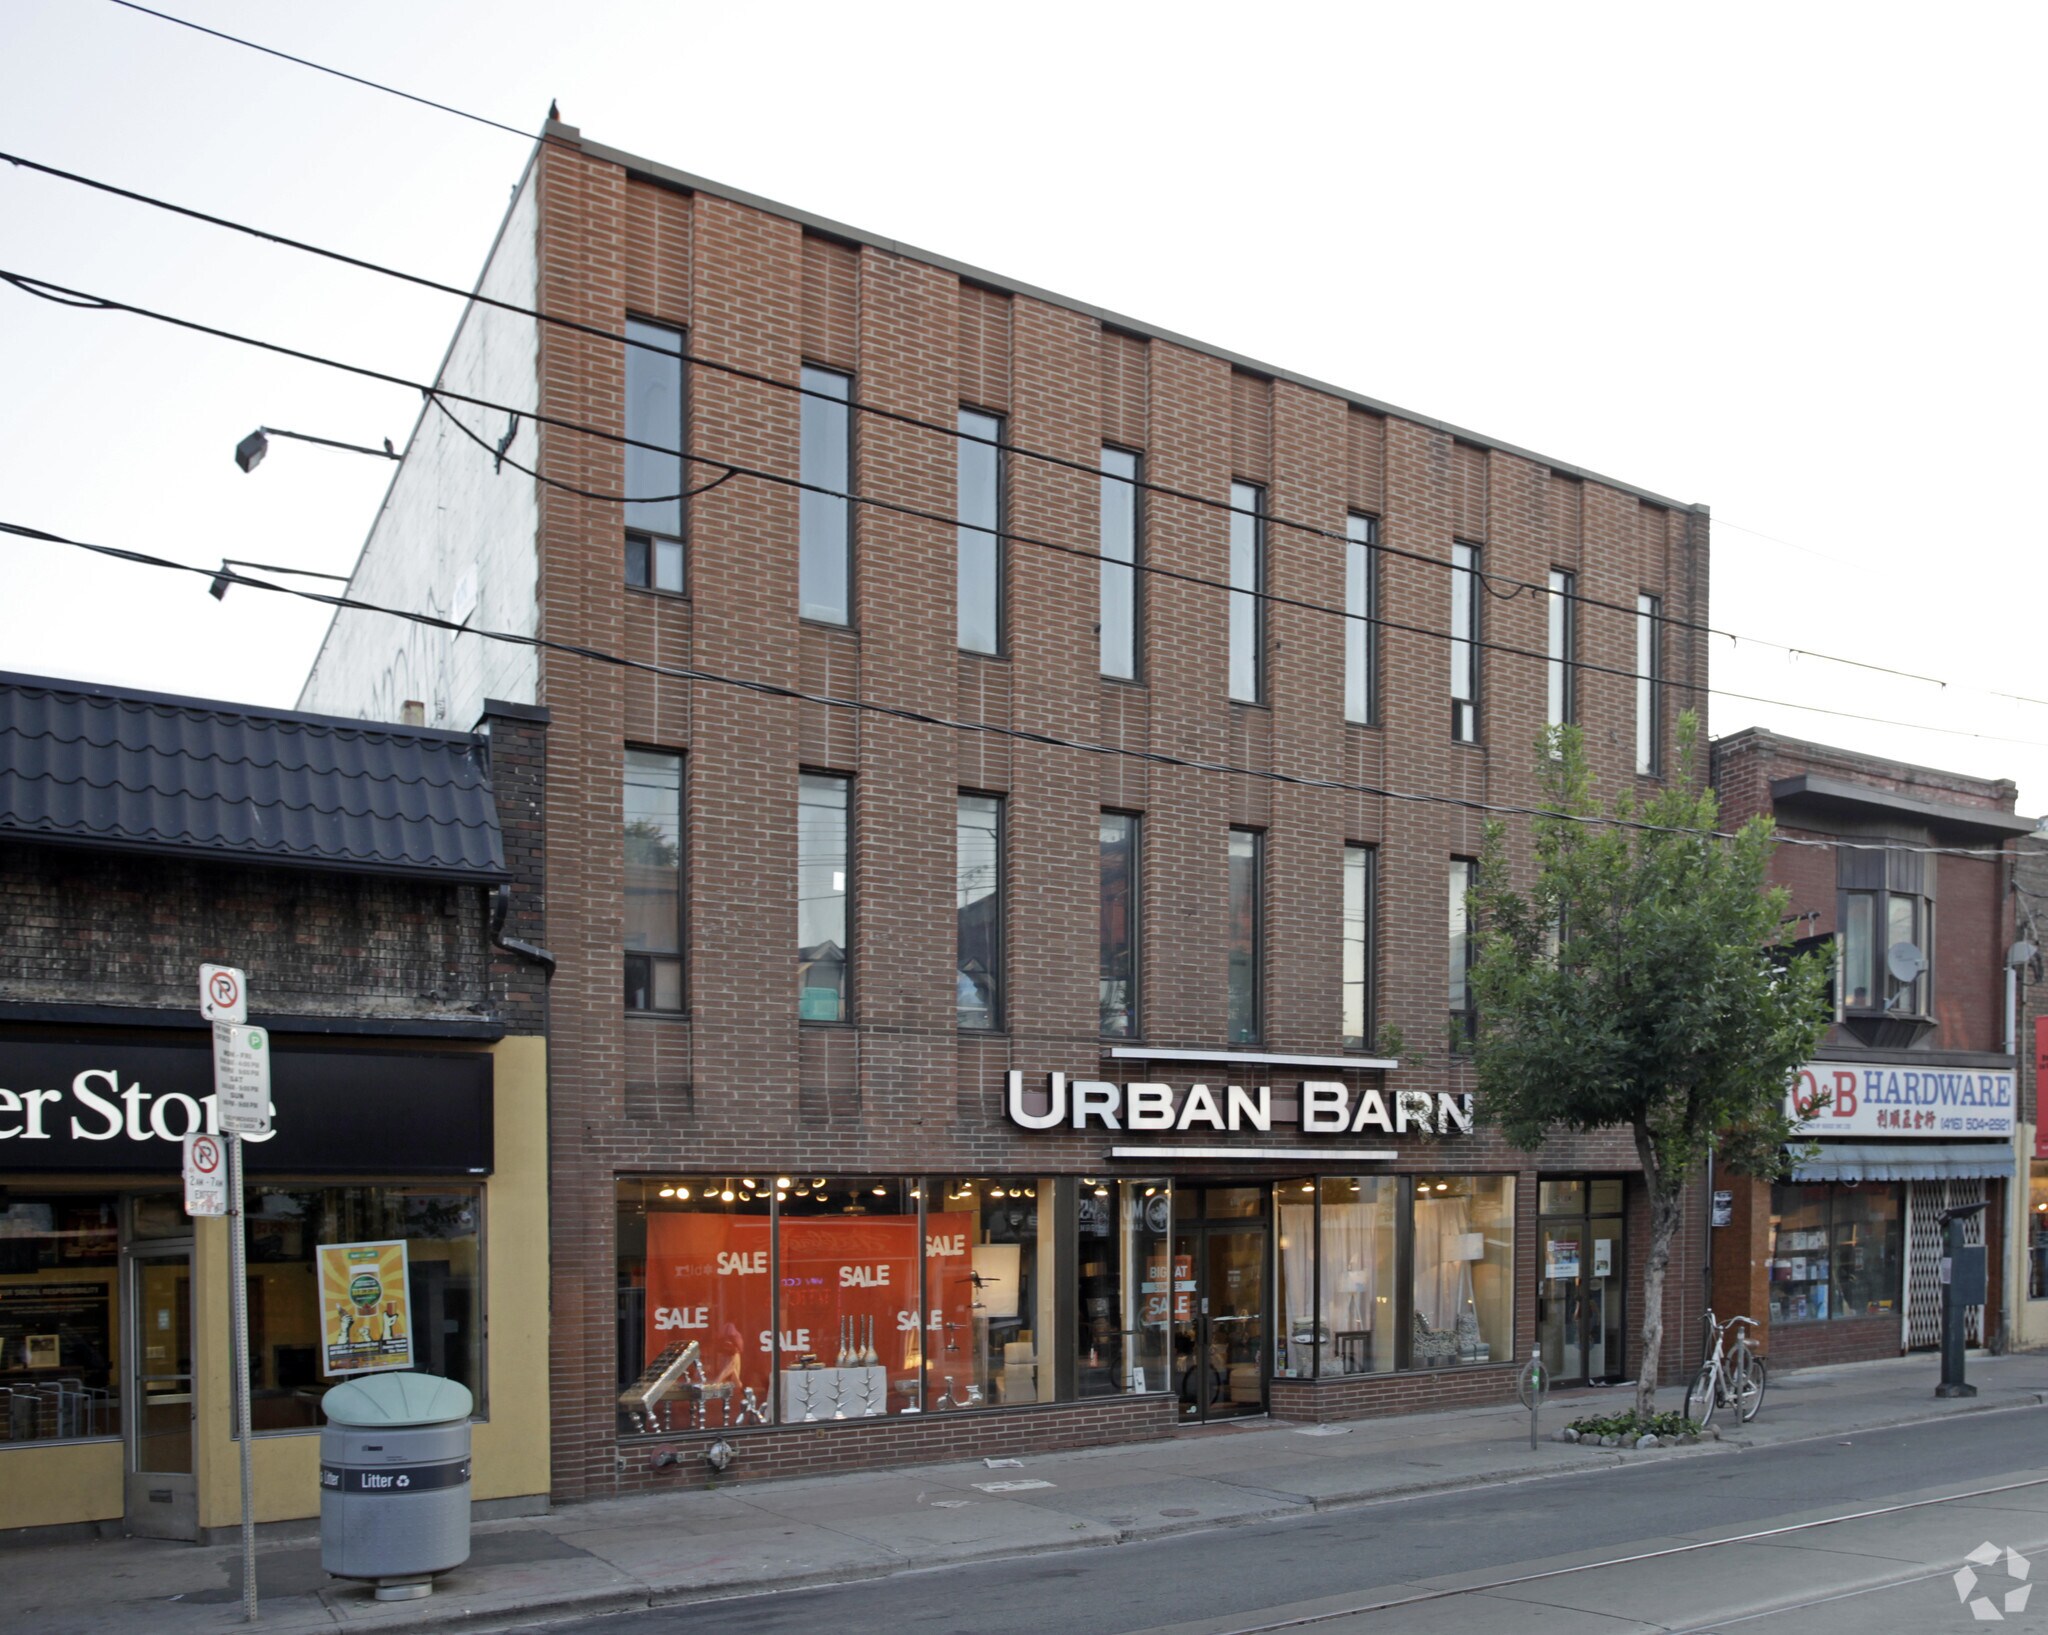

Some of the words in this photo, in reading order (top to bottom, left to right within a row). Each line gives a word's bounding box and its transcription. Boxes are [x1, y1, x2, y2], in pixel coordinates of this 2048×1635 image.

[1863, 1070, 2010, 1107] HARDWARE
[71, 1069, 276, 1143] Stor
[1006, 1070, 1271, 1131] URBAN
[1302, 1081, 1474, 1135] BARN
[717, 1252, 767, 1275] SALE
[839, 1264, 890, 1287] SALE
[655, 1307, 709, 1330] SALE
[361, 1473, 394, 1489] Litter
